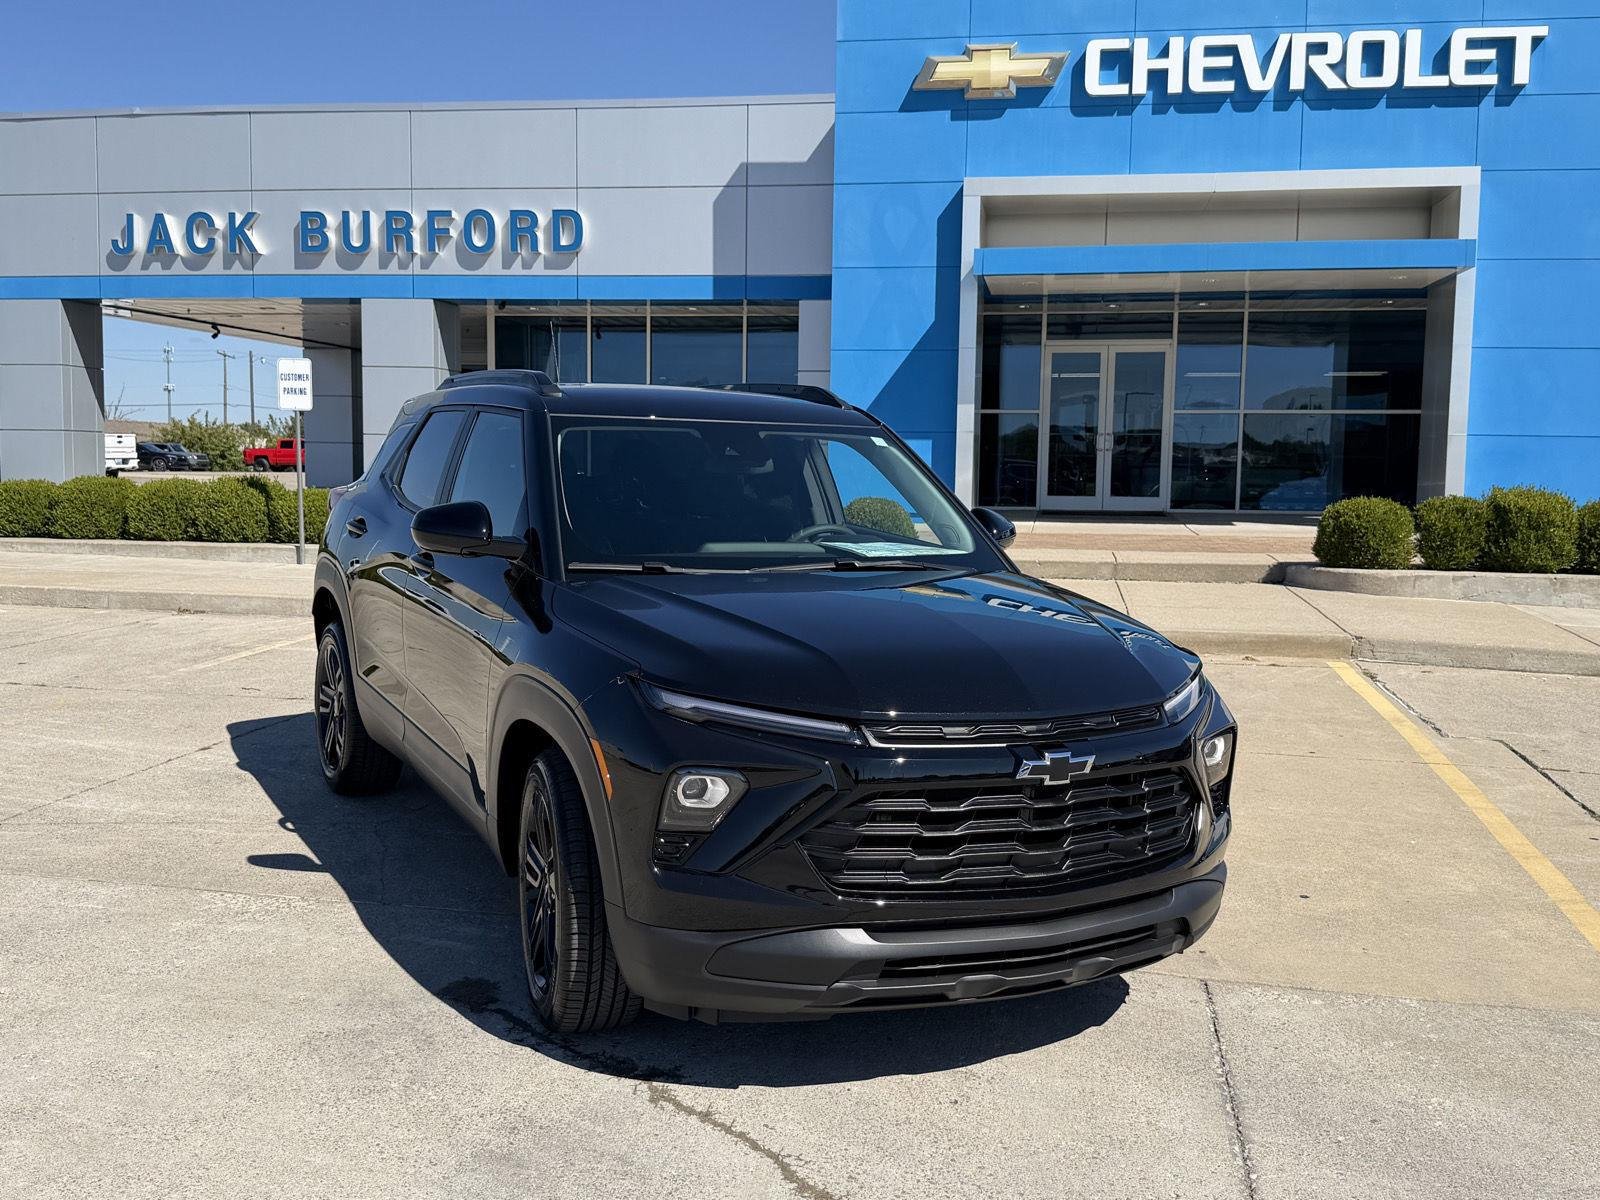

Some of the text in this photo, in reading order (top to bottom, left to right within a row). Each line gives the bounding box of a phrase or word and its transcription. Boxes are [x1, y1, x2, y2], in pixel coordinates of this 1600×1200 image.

[1084, 25, 1549, 96] CHEVROLET
[111, 208, 584, 255] JACK BURFORD
[280, 373, 310, 381] CUSTOMER
[283, 387, 308, 395] PARKING
